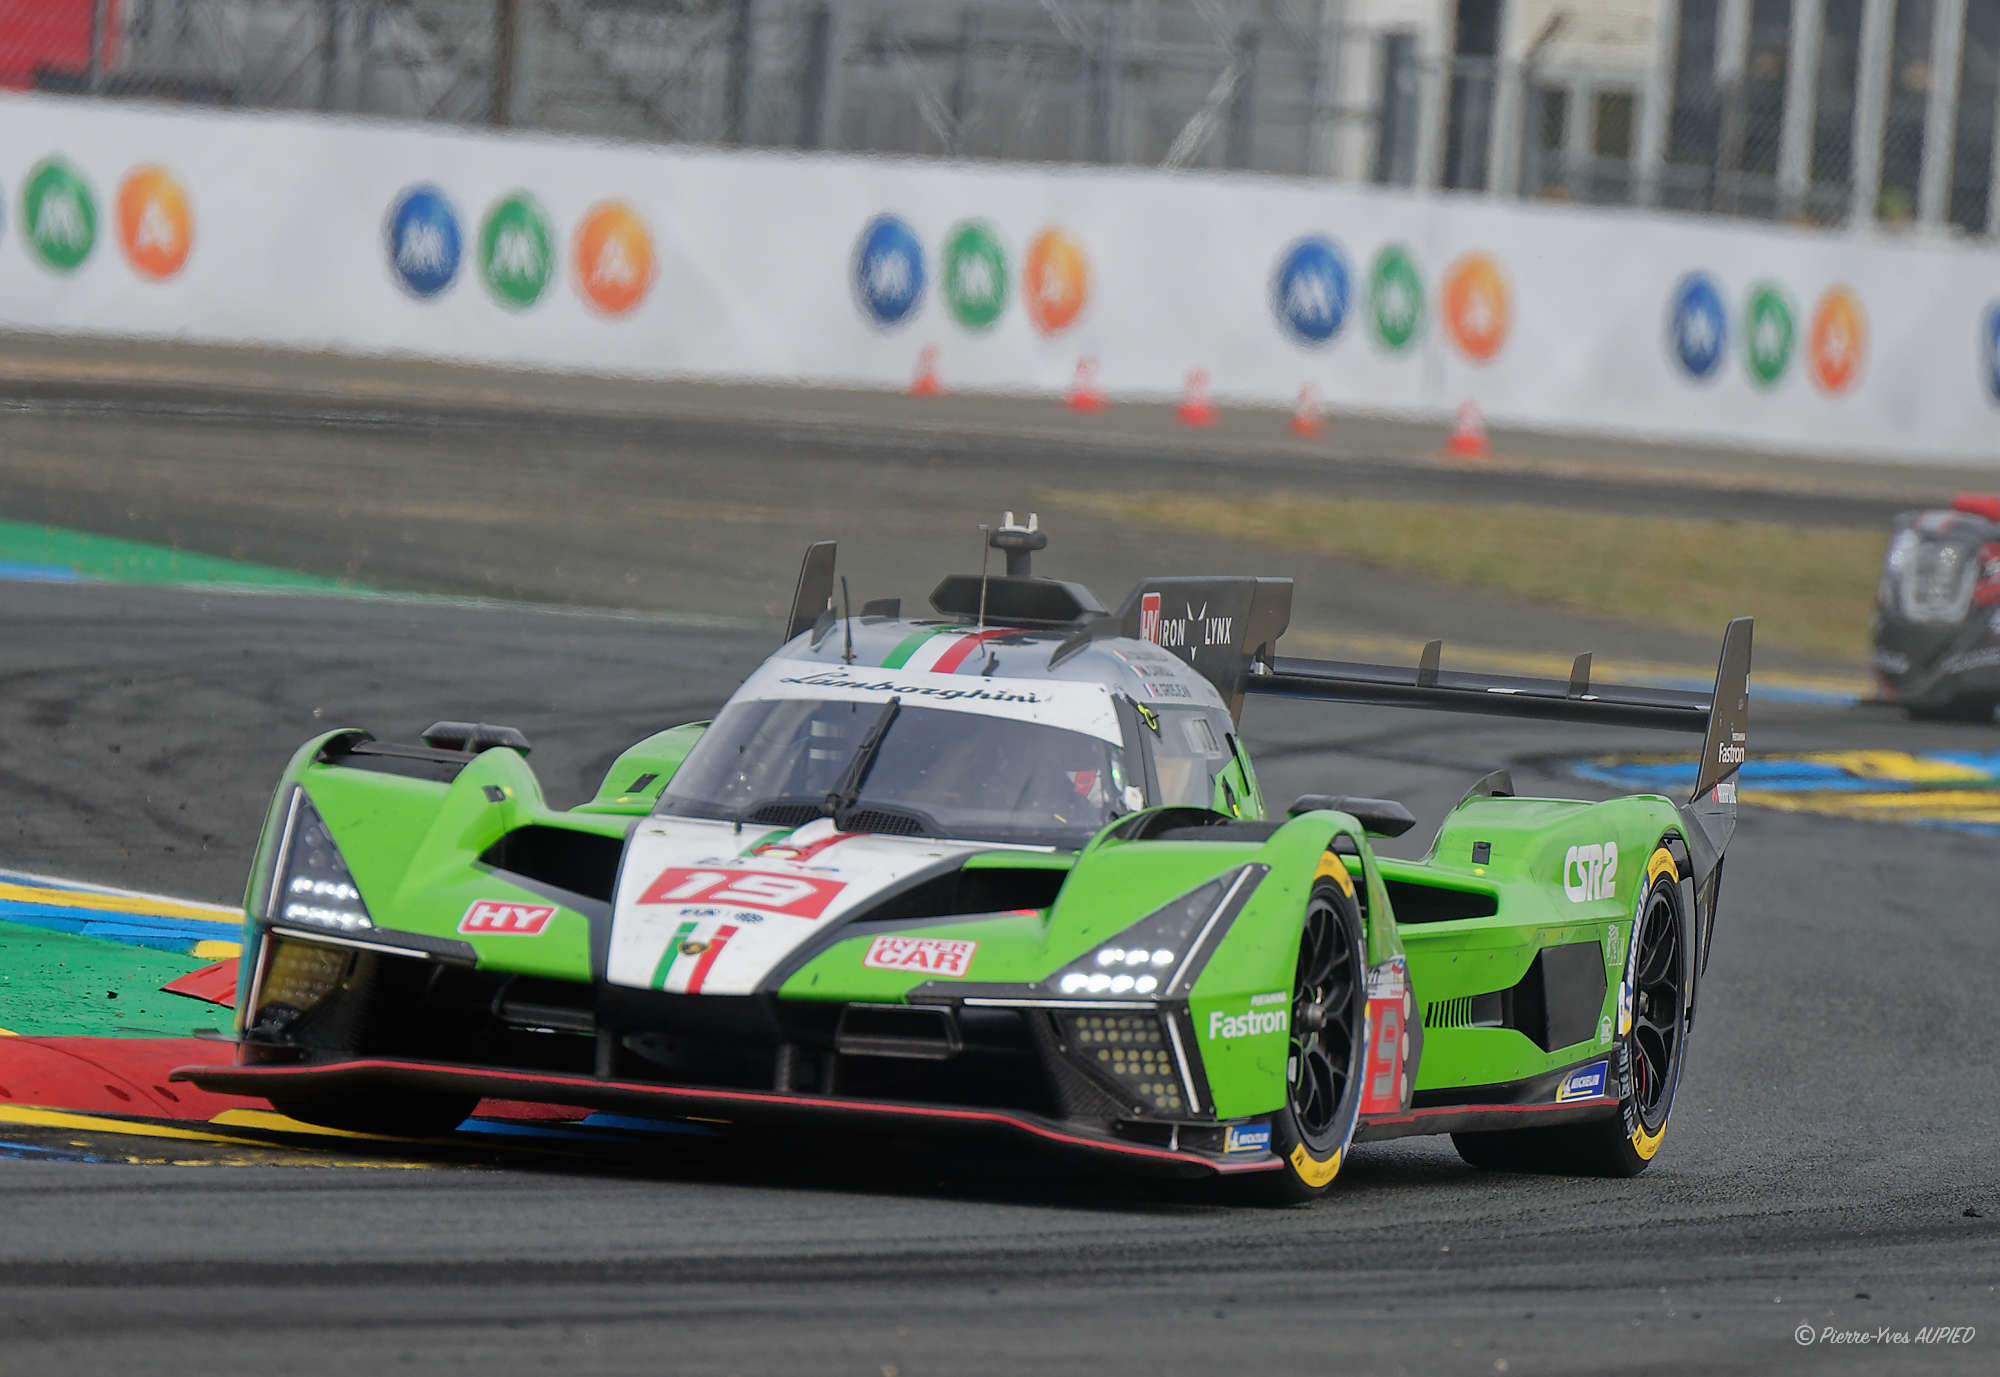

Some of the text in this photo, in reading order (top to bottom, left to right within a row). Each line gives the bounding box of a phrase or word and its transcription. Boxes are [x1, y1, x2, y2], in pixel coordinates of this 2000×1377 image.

[1159, 616, 1232, 647] IRON LYNX
[780, 672, 1042, 703] Lamborghini
[1718, 742, 1745, 764] Fastron
[1563, 841, 1618, 903] CSR2
[659, 870, 818, 908] 19
[468, 904, 548, 929] HY
[873, 948, 963, 972] CAR
[1208, 1009, 1287, 1041] Fastron
